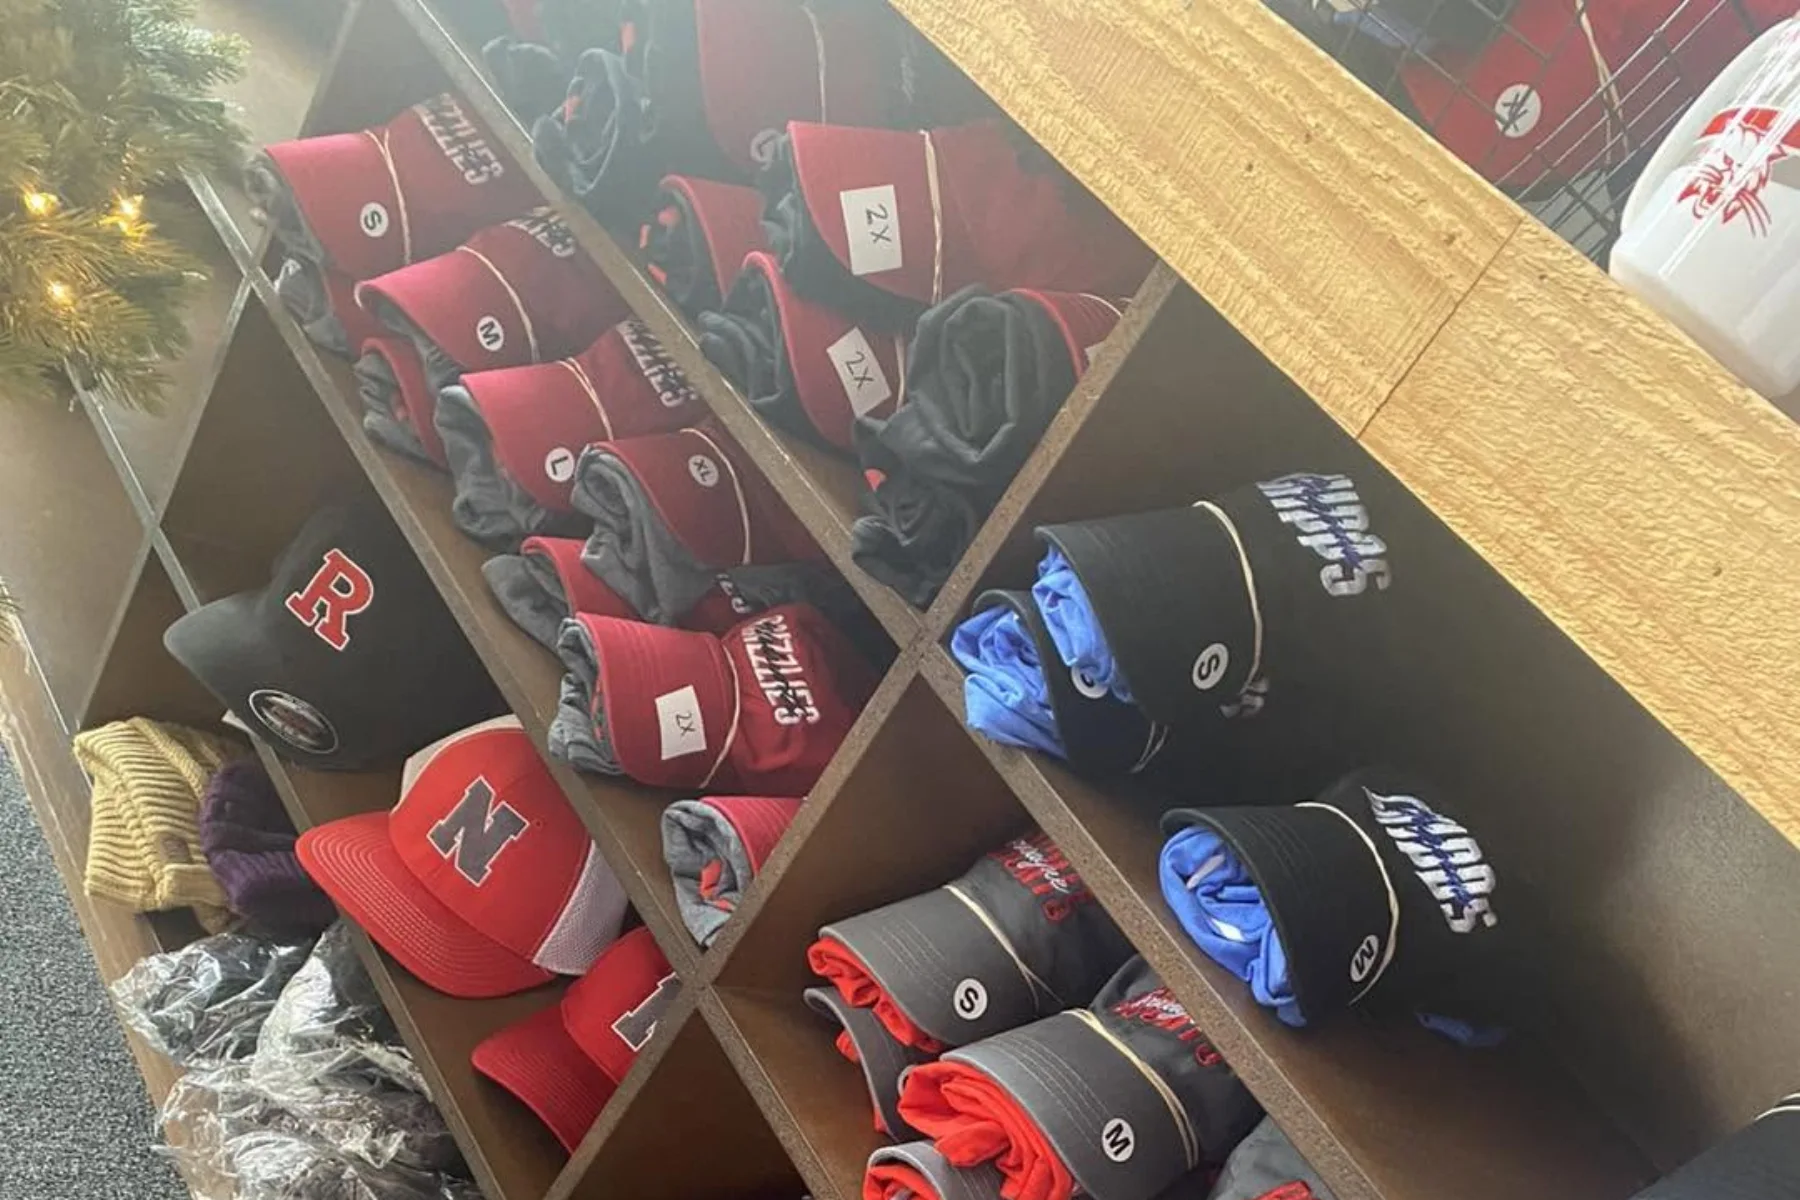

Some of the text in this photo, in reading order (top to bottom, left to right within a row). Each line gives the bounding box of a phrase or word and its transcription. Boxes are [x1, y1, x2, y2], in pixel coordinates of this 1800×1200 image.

[865, 202, 893, 246] 2X
[479, 320, 500, 347] M
[844, 350, 876, 390] 2X
[549, 454, 571, 477] L
[693, 458, 718, 483] XL
[286, 547, 375, 652] R
[1197, 652, 1222, 683] S
[673, 709, 696, 736] 2X
[426, 773, 531, 889] N
[1351, 938, 1377, 975] M
[957, 985, 982, 1014] S
[1104, 1124, 1132, 1157] M
